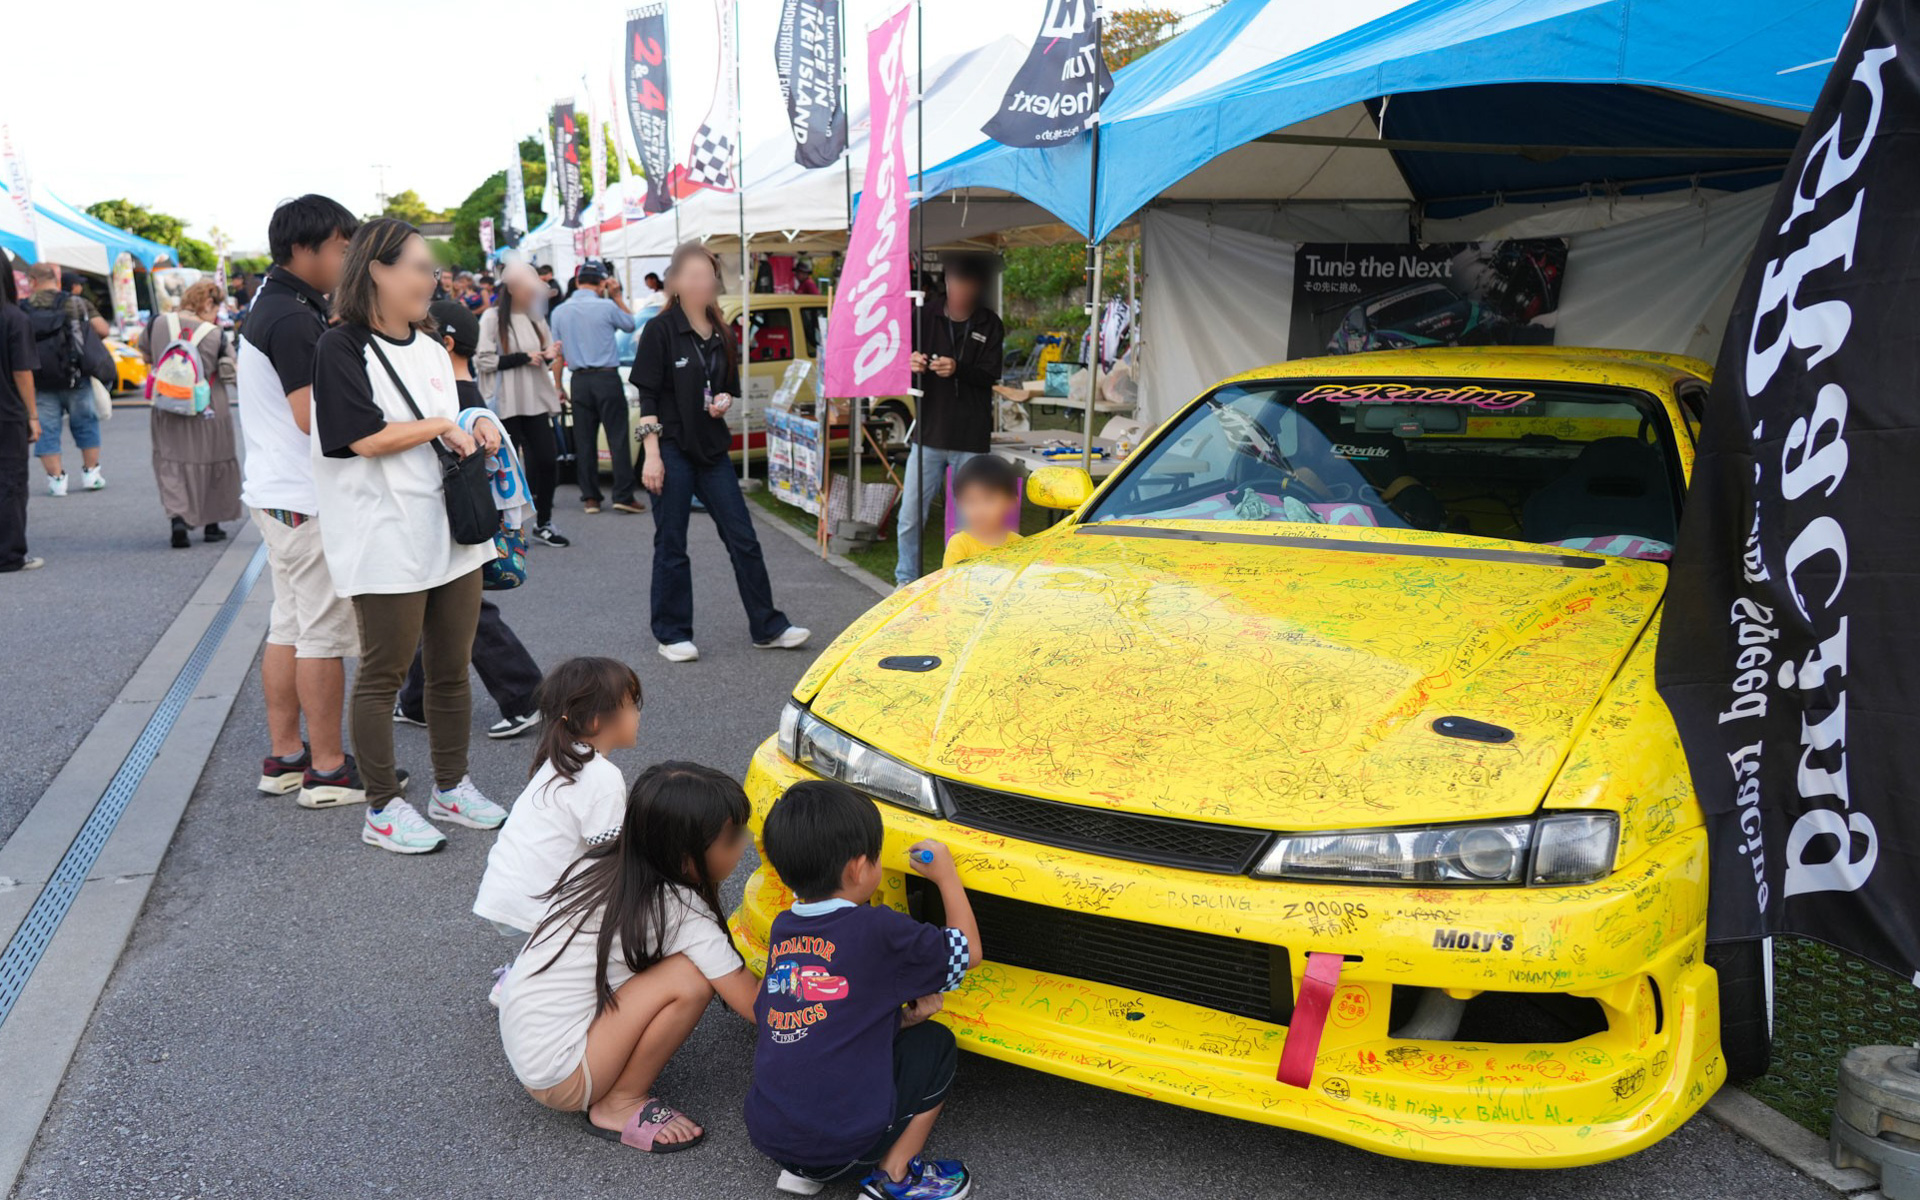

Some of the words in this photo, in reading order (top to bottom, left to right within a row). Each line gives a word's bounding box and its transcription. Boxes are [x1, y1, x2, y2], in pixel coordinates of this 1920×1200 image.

[800, 2, 817, 50] IKEI
[825, 16, 836, 60] Uruma
[633, 32, 663, 67] 2
[637, 78, 666, 111] 4
[793, 57, 815, 145] ISLAND
[813, 78, 829, 108] IN
[1305, 254, 1356, 277] Tune
[1359, 256, 1396, 278] the
[1398, 255, 1454, 279] Next
[1304, 281, 1362, 294] その先に挑め。
[1297, 384, 1536, 410] PSRacing
[1329, 443, 1390, 458] GReddy
[771, 936, 834, 967] ADIATOR
[1432, 928, 1515, 953] Moty's
